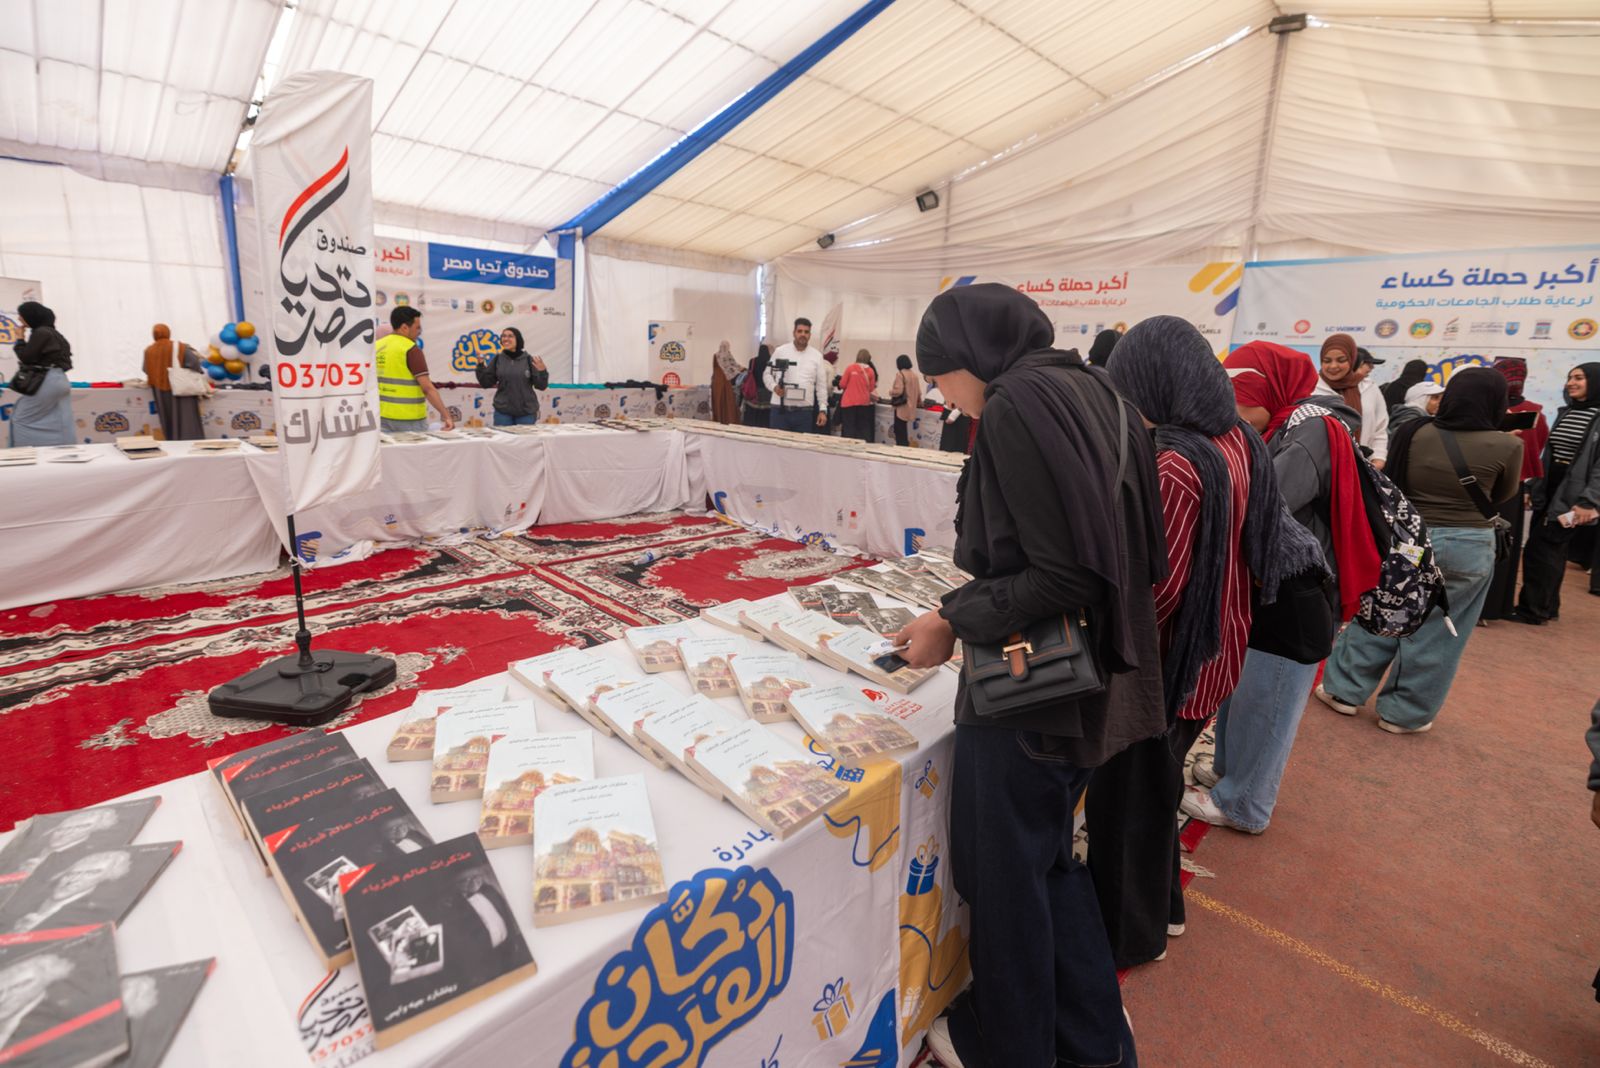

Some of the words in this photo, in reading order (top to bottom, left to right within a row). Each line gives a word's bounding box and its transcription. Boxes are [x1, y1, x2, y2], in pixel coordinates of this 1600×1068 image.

[316, 228, 366, 256] صندوق
[381, 243, 411, 262] أكبر
[442, 257, 473, 271] مصر
[476, 258, 502, 275] تحيا
[504, 262, 550, 279] صندوق
[1096, 271, 1128, 294] أكبر
[1381, 268, 1455, 289] كساء
[1462, 268, 1528, 286] حملة
[1533, 258, 1600, 290] أكبر
[1017, 278, 1055, 293] كساء
[1058, 278, 1093, 291] حملة
[1375, 298, 1435, 310] الحكومية
[1437, 296, 1500, 307] الجامعات
[1502, 296, 1541, 306] طلاب
[1545, 296, 1593, 308] لرعاية
[277, 363, 371, 388] 03703
[712, 829, 777, 862] بادرة
[430, 851, 471, 871] مذكرات
[402, 866, 428, 882] عالم
